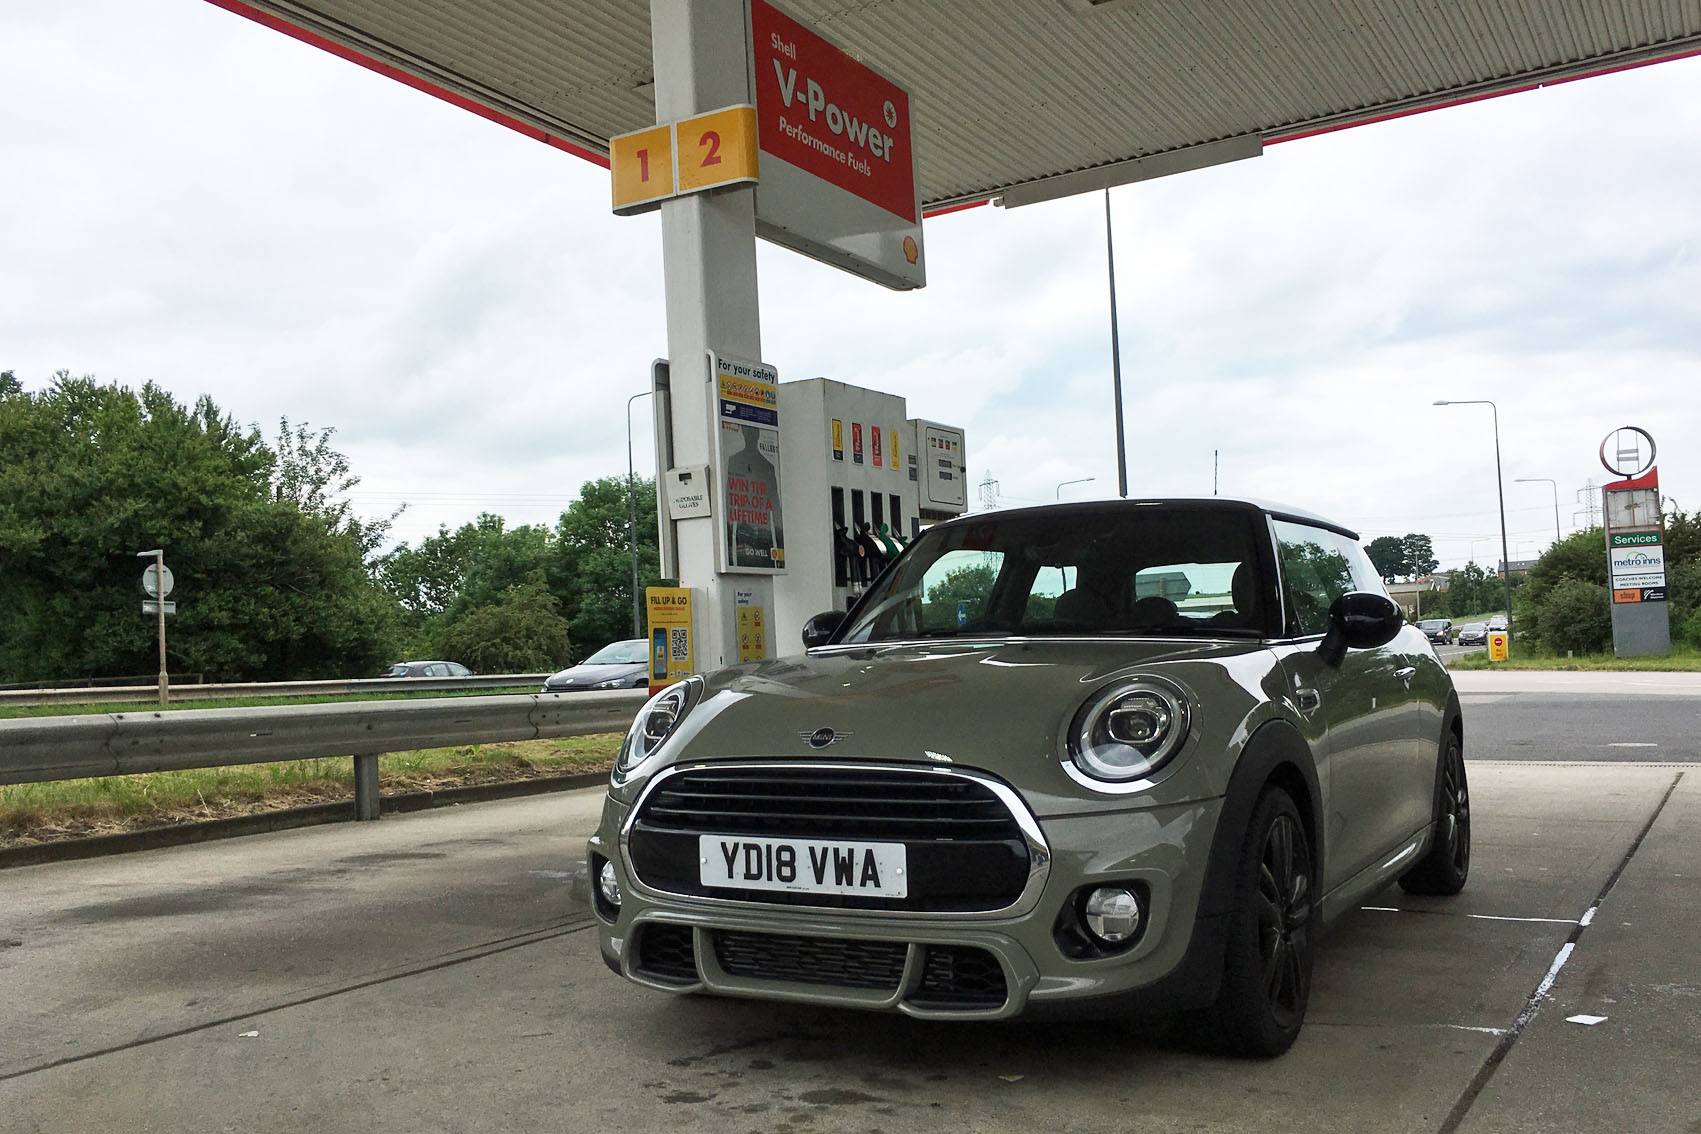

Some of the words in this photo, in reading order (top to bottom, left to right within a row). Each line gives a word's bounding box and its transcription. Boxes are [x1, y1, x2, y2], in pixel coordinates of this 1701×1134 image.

[771, 32, 797, 59] Shell
[772, 58, 894, 163] V-Power
[699, 130, 722, 168] 2
[779, 116, 846, 165] Performance
[847, 154, 872, 177] Fuels
[636, 149, 650, 183] 1
[718, 359, 731, 371] For
[733, 364, 751, 376] your
[752, 367, 776, 384] safety
[728, 478, 749, 492] WIN
[728, 493, 749, 506] TRIP
[751, 497, 764, 509] OF
[765, 500, 774, 511] A
[745, 547, 755, 556] GO
[1614, 535, 1658, 544] Services
[1614, 558, 1641, 566] metro
[1642, 556, 1661, 565] inns
[650, 596, 661, 605] FILL
[662, 596, 671, 605] UP
[677, 596, 688, 605] GO
[720, 841, 797, 883] YD18
[808, 846, 881, 888] VWA
